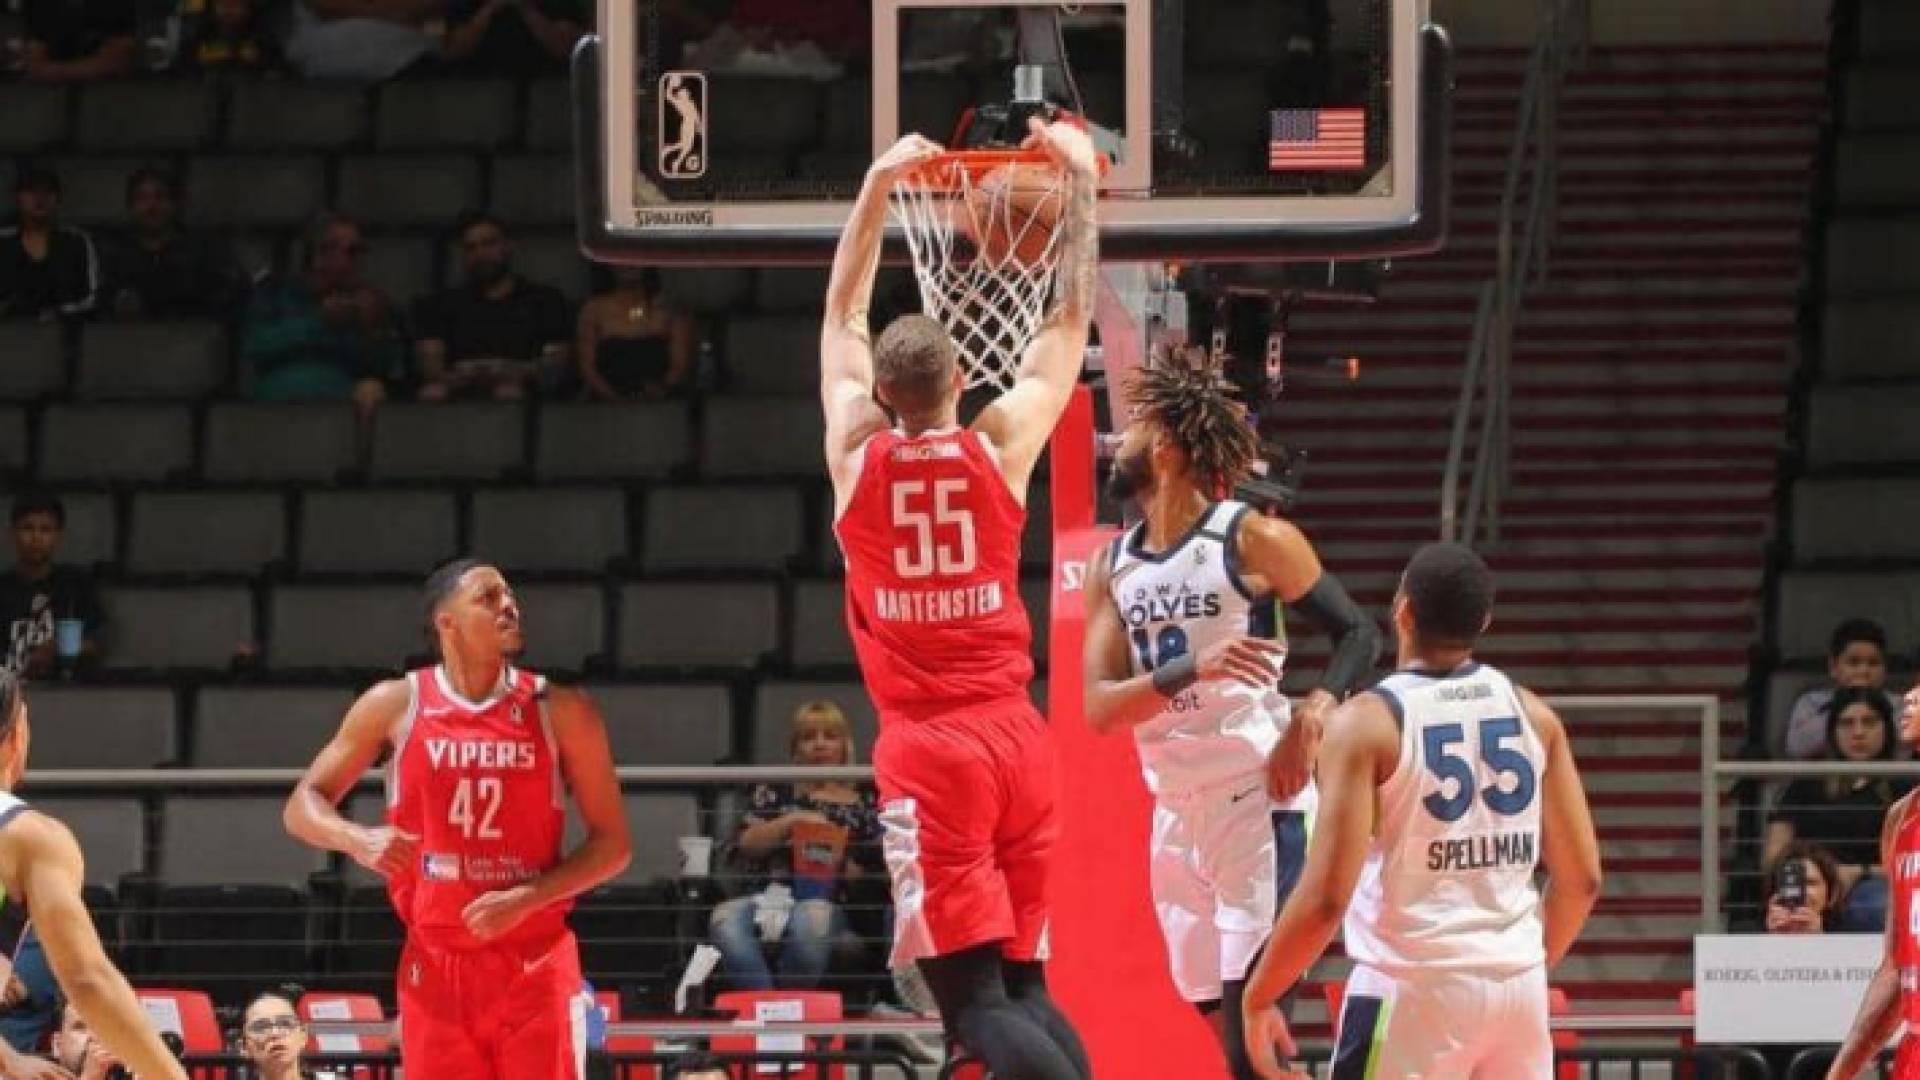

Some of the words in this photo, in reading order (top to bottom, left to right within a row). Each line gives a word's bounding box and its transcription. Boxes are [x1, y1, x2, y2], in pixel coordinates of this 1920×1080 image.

[892, 478, 976, 578] 55
[423, 737, 536, 771] VIPERS
[1423, 717, 1535, 822] 55
[447, 777, 503, 840] 42
[1427, 830, 1535, 871] SPELLMAN
